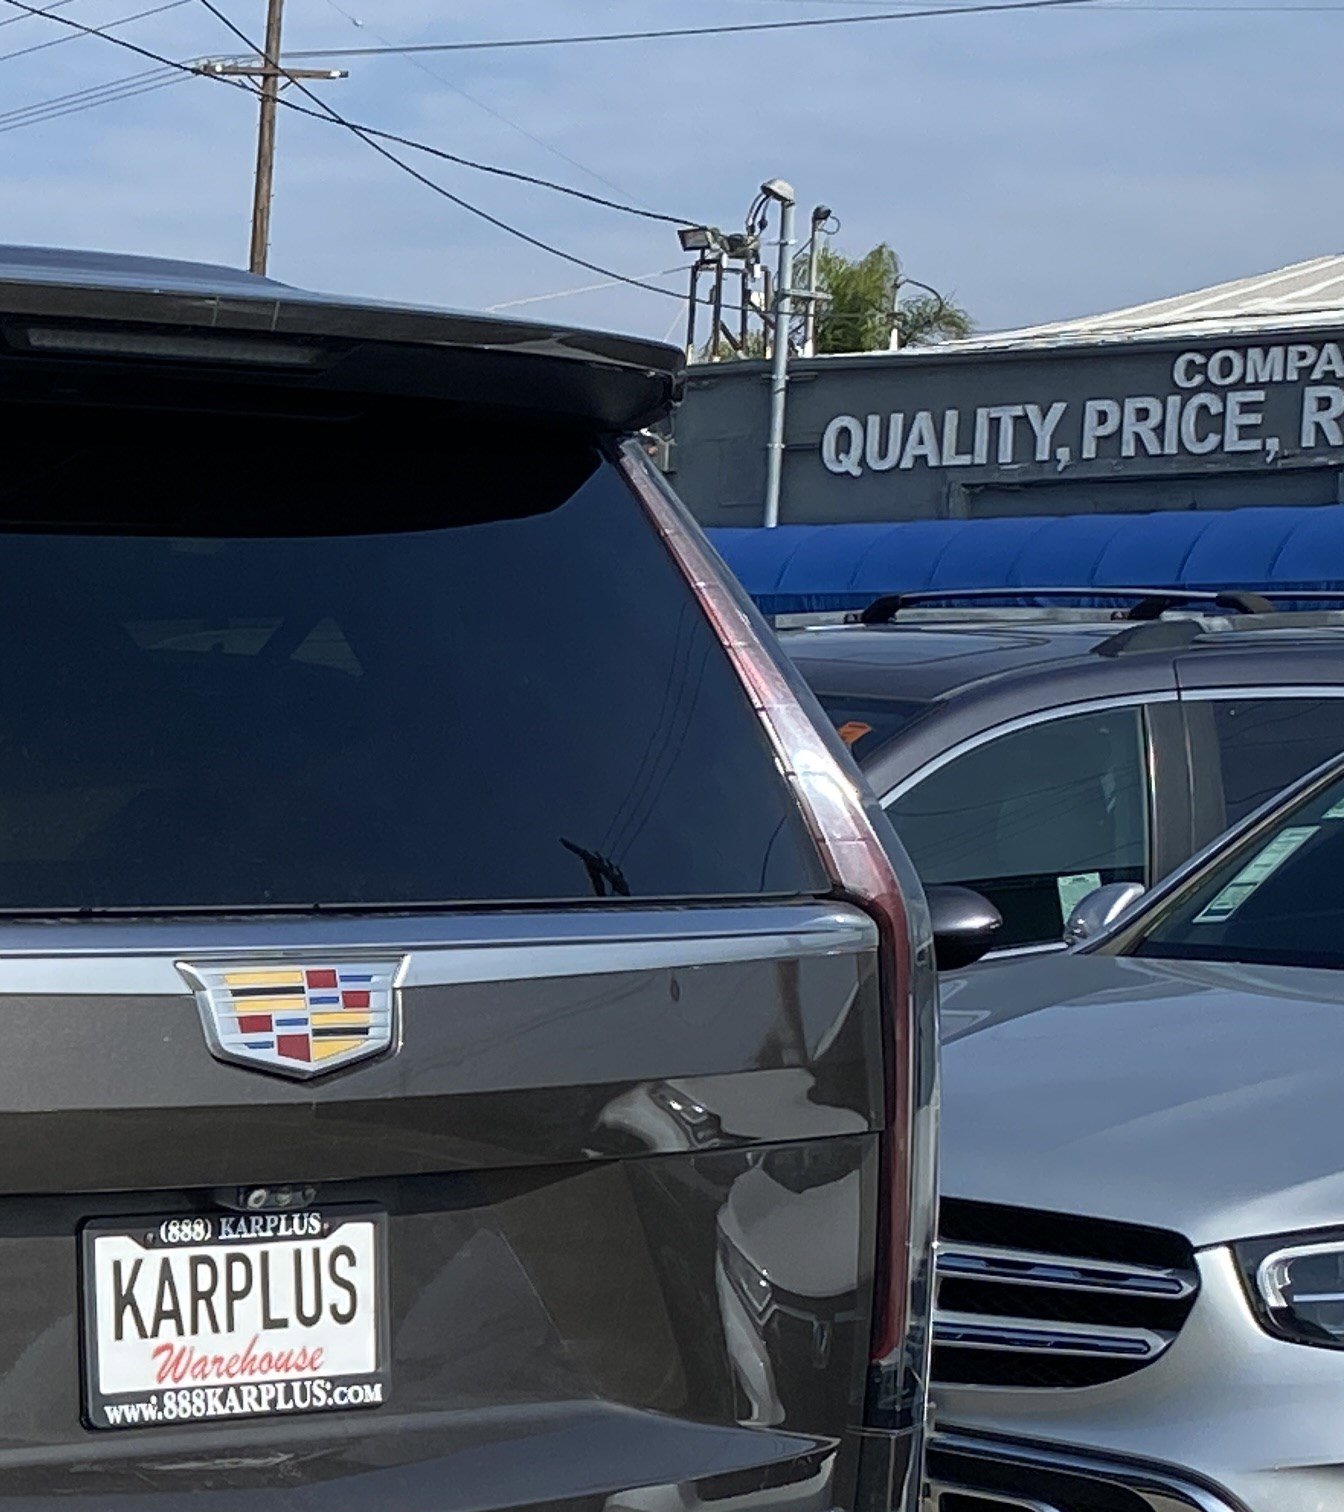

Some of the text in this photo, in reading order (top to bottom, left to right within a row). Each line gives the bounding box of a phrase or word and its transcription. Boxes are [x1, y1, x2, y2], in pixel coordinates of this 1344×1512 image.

[1174, 343, 1344, 388] COMPA
[821, 385, 1344, 477] QUALITY, PRICE, R
[159, 1212, 322, 1244] (888) KARPLUS
[112, 1244, 359, 1342] KARPLUS
[150, 1334, 325, 1385] Warehouse
